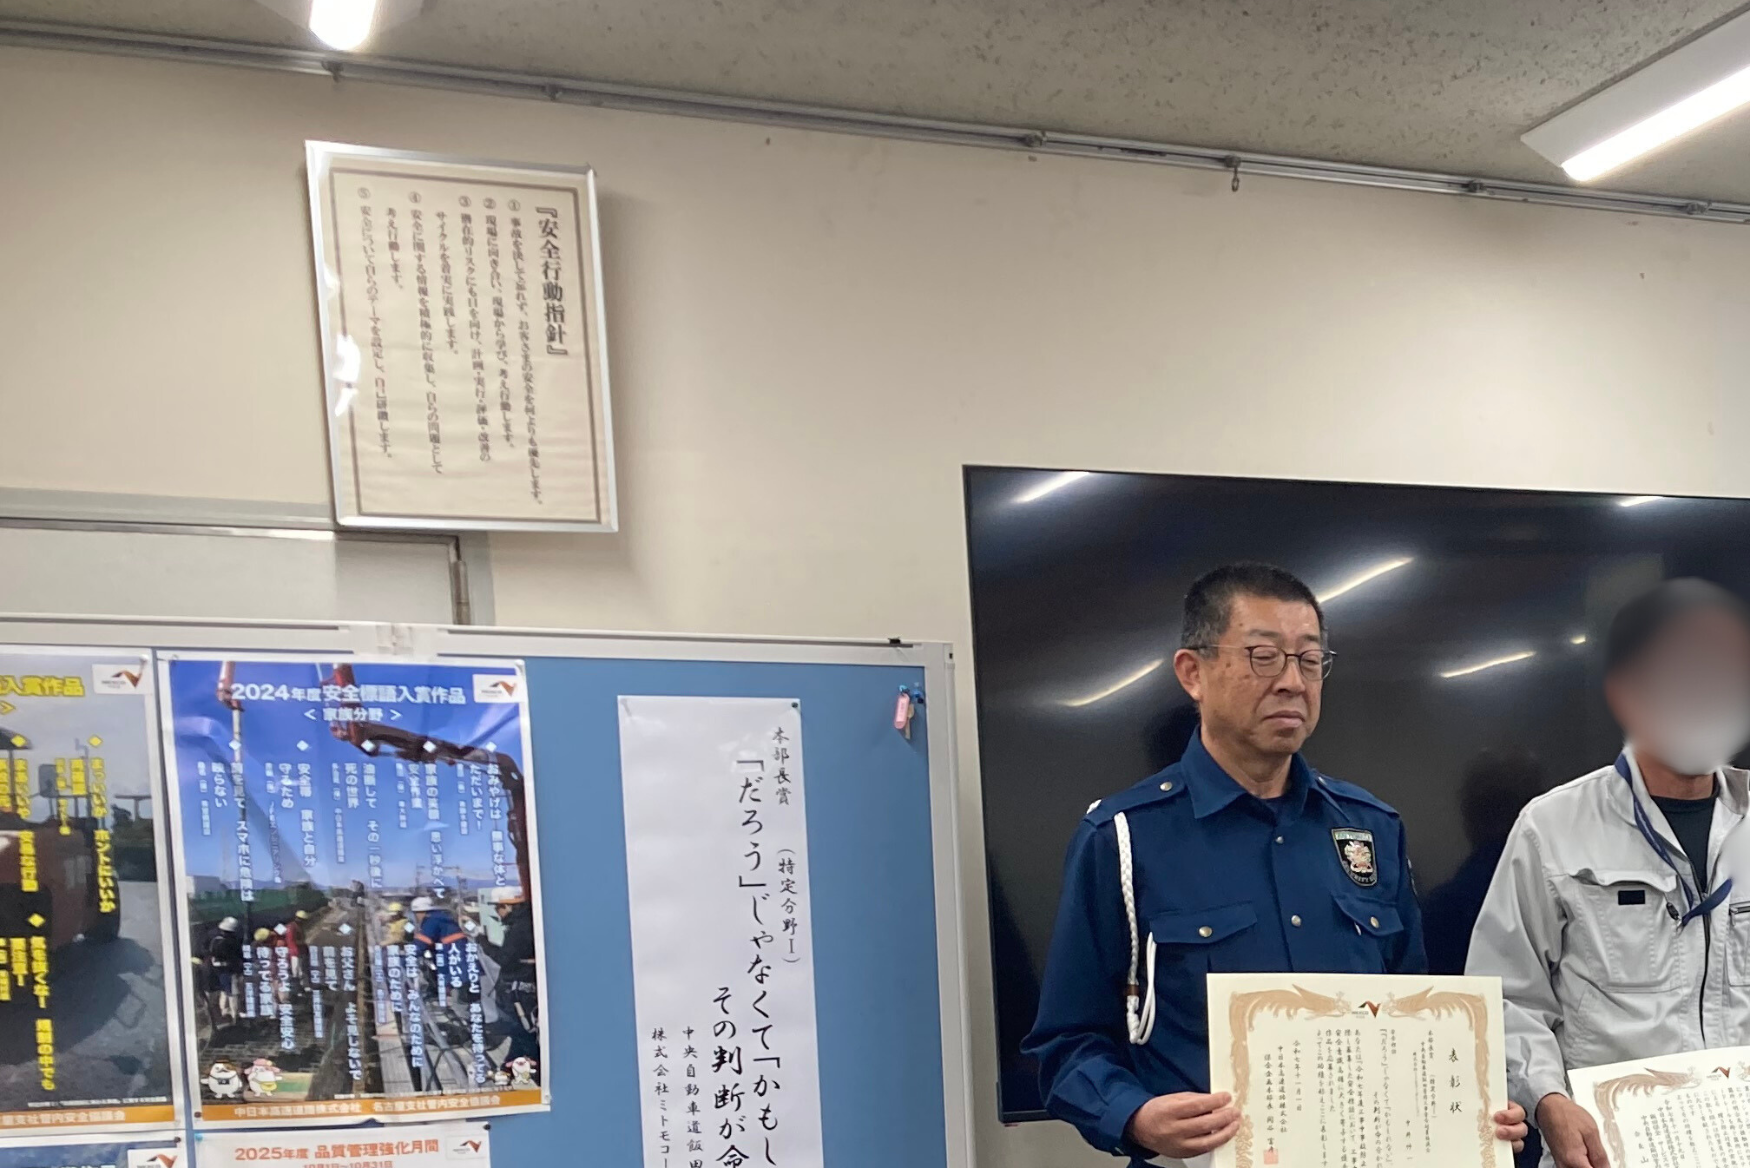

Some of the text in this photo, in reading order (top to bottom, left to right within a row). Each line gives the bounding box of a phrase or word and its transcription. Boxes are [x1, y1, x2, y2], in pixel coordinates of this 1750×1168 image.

[536, 206, 568, 356] 『安全行動指針』
[772, 726, 791, 806] 本部長賞
[1448, 1046, 1463, 1115] 表彰状
[235, 1139, 439, 1161] 2025年度 品質管理強化月間
